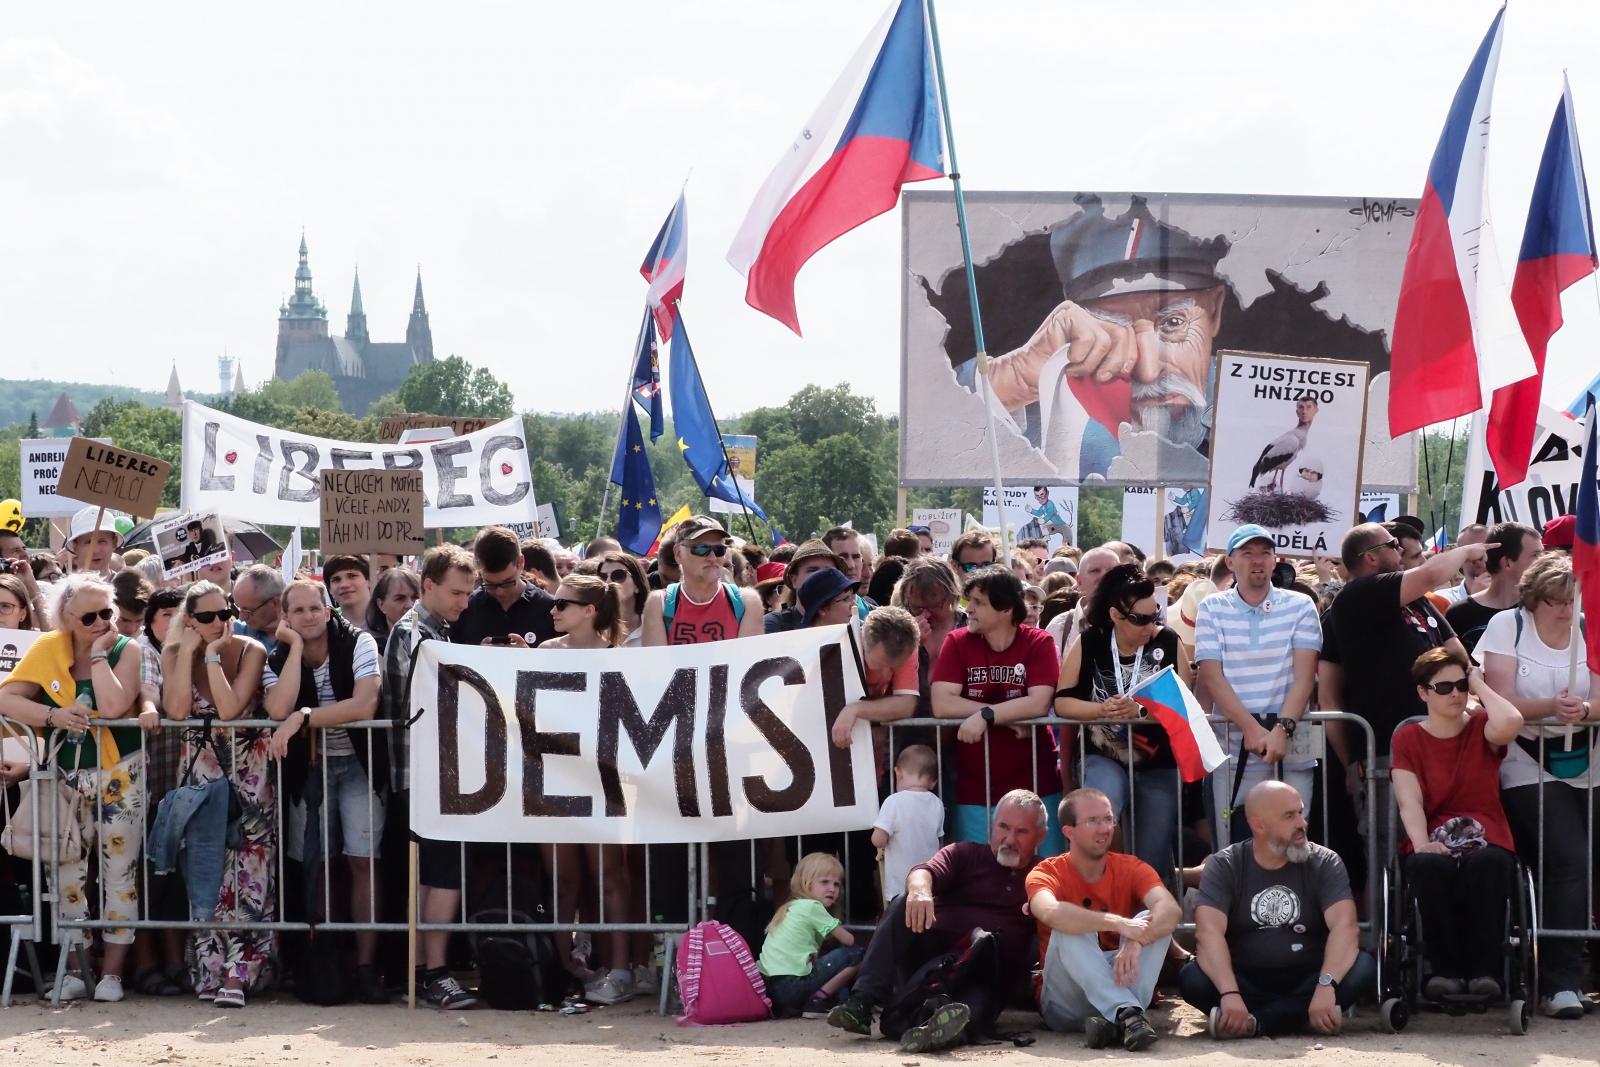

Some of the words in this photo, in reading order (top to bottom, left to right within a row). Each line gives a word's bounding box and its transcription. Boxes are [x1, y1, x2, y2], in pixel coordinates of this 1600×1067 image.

[1230, 363, 1243, 377] Z
[1248, 365, 1332, 386] JUSTICE
[1334, 373, 1356, 387] SI
[34, 467, 58, 479] PROČ
[86, 446, 158, 477] LIBEREC
[74, 466, 145, 502] NEMLČÍ
[324, 471, 383, 494] NECHCEM
[325, 519, 369, 544] TÁHNI
[1272, 531, 1328, 551] DĚLÁ
[437, 642, 857, 818] DEMISI
